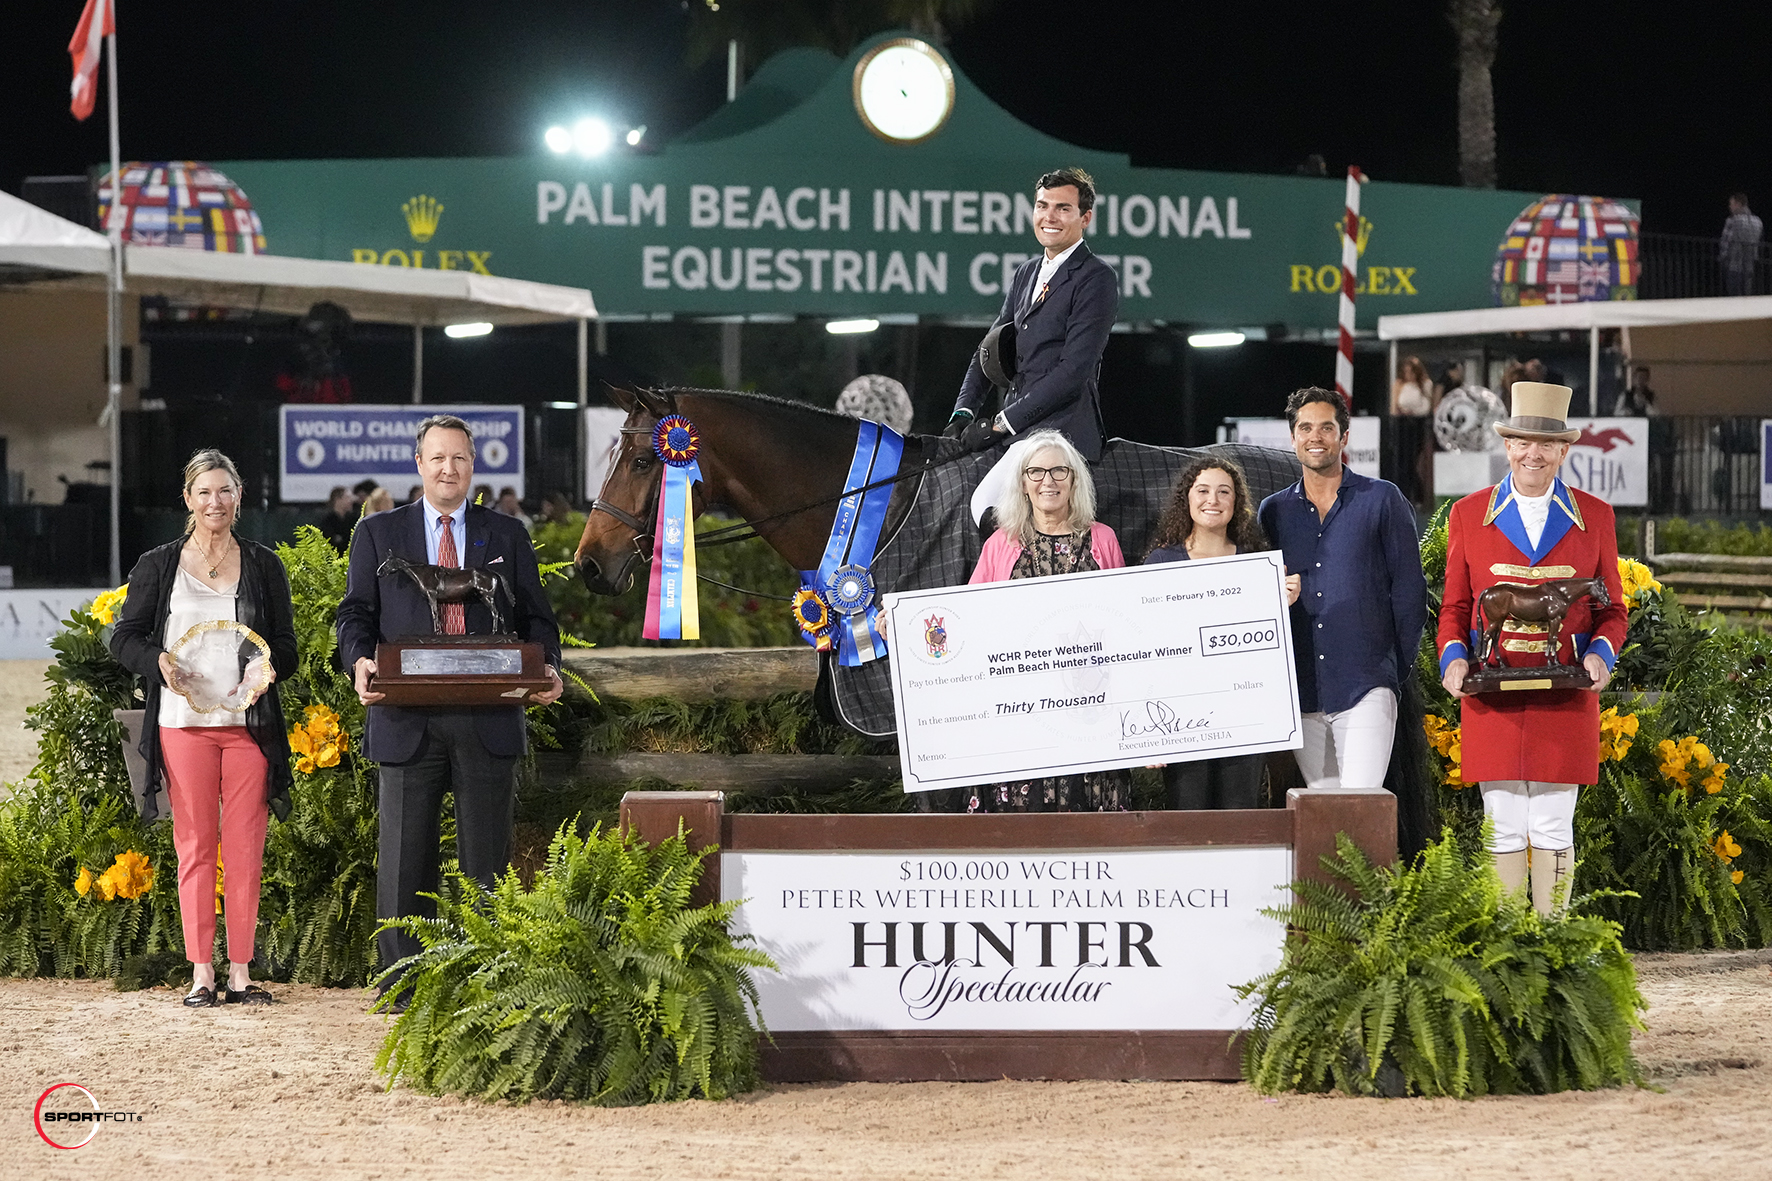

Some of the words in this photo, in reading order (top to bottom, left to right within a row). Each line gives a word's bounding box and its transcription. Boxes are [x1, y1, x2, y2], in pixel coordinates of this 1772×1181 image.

[537, 180, 667, 227] PALM
[689, 184, 851, 231] BEACH
[872, 188, 1252, 240] INTERNTIONAL
[642, 245, 948, 295] EQUESTRIAN
[1290, 264, 1418, 295] ROEX
[294, 420, 364, 438] WORLD
[336, 444, 414, 461] HUNTER
[1559, 450, 1626, 497] SHJA
[1141, 595, 1163, 605] Date:
[1166, 592, 1204, 602] February
[1206, 590, 1218, 598] 19,
[1220, 587, 1242, 596] 2022
[1208, 629, 1275, 649] $30,000
[987, 651, 1022, 664] WCHR
[1025, 649, 1052, 660] Peter
[1055, 641, 1103, 656] Wetherill
[908, 679, 923, 689] Pay
[925, 679, 934, 687] to
[935, 676, 949, 686] the
[950, 673, 973, 684] order
[974, 672, 986, 681] of:
[989, 665, 1015, 677] Palm
[1018, 660, 1050, 673] Beach
[1052, 657, 1087, 669] Hunter
[1090, 650, 1152, 666] Spectacular
[1155, 645, 1193, 658] Winner
[1233, 680, 1264, 691] Dollars
[918, 718, 928, 726] In
[929, 715, 943, 725] the
[944, 713, 977, 723] amount
[978, 710, 990, 720] of:
[995, 701, 1035, 714] Thirty
[1039, 692, 1106, 709] Thousand
[1118, 738, 1160, 751] Executive
[1161, 735, 1199, 747] Director,
[1201, 731, 1232, 742] USHJA
[917, 753, 947, 762] Memo:
[899, 860, 1009, 882] $100,000
[1020, 860, 1114, 880] WCHR
[782, 889, 867, 909] PETER
[875, 889, 1040, 909] WETHERILL
[1052, 888, 1125, 908] PALM
[1137, 888, 1229, 908] BEACH
[848, 921, 1163, 968] HUNTER
[899, 957, 1112, 1021] Spectacular
